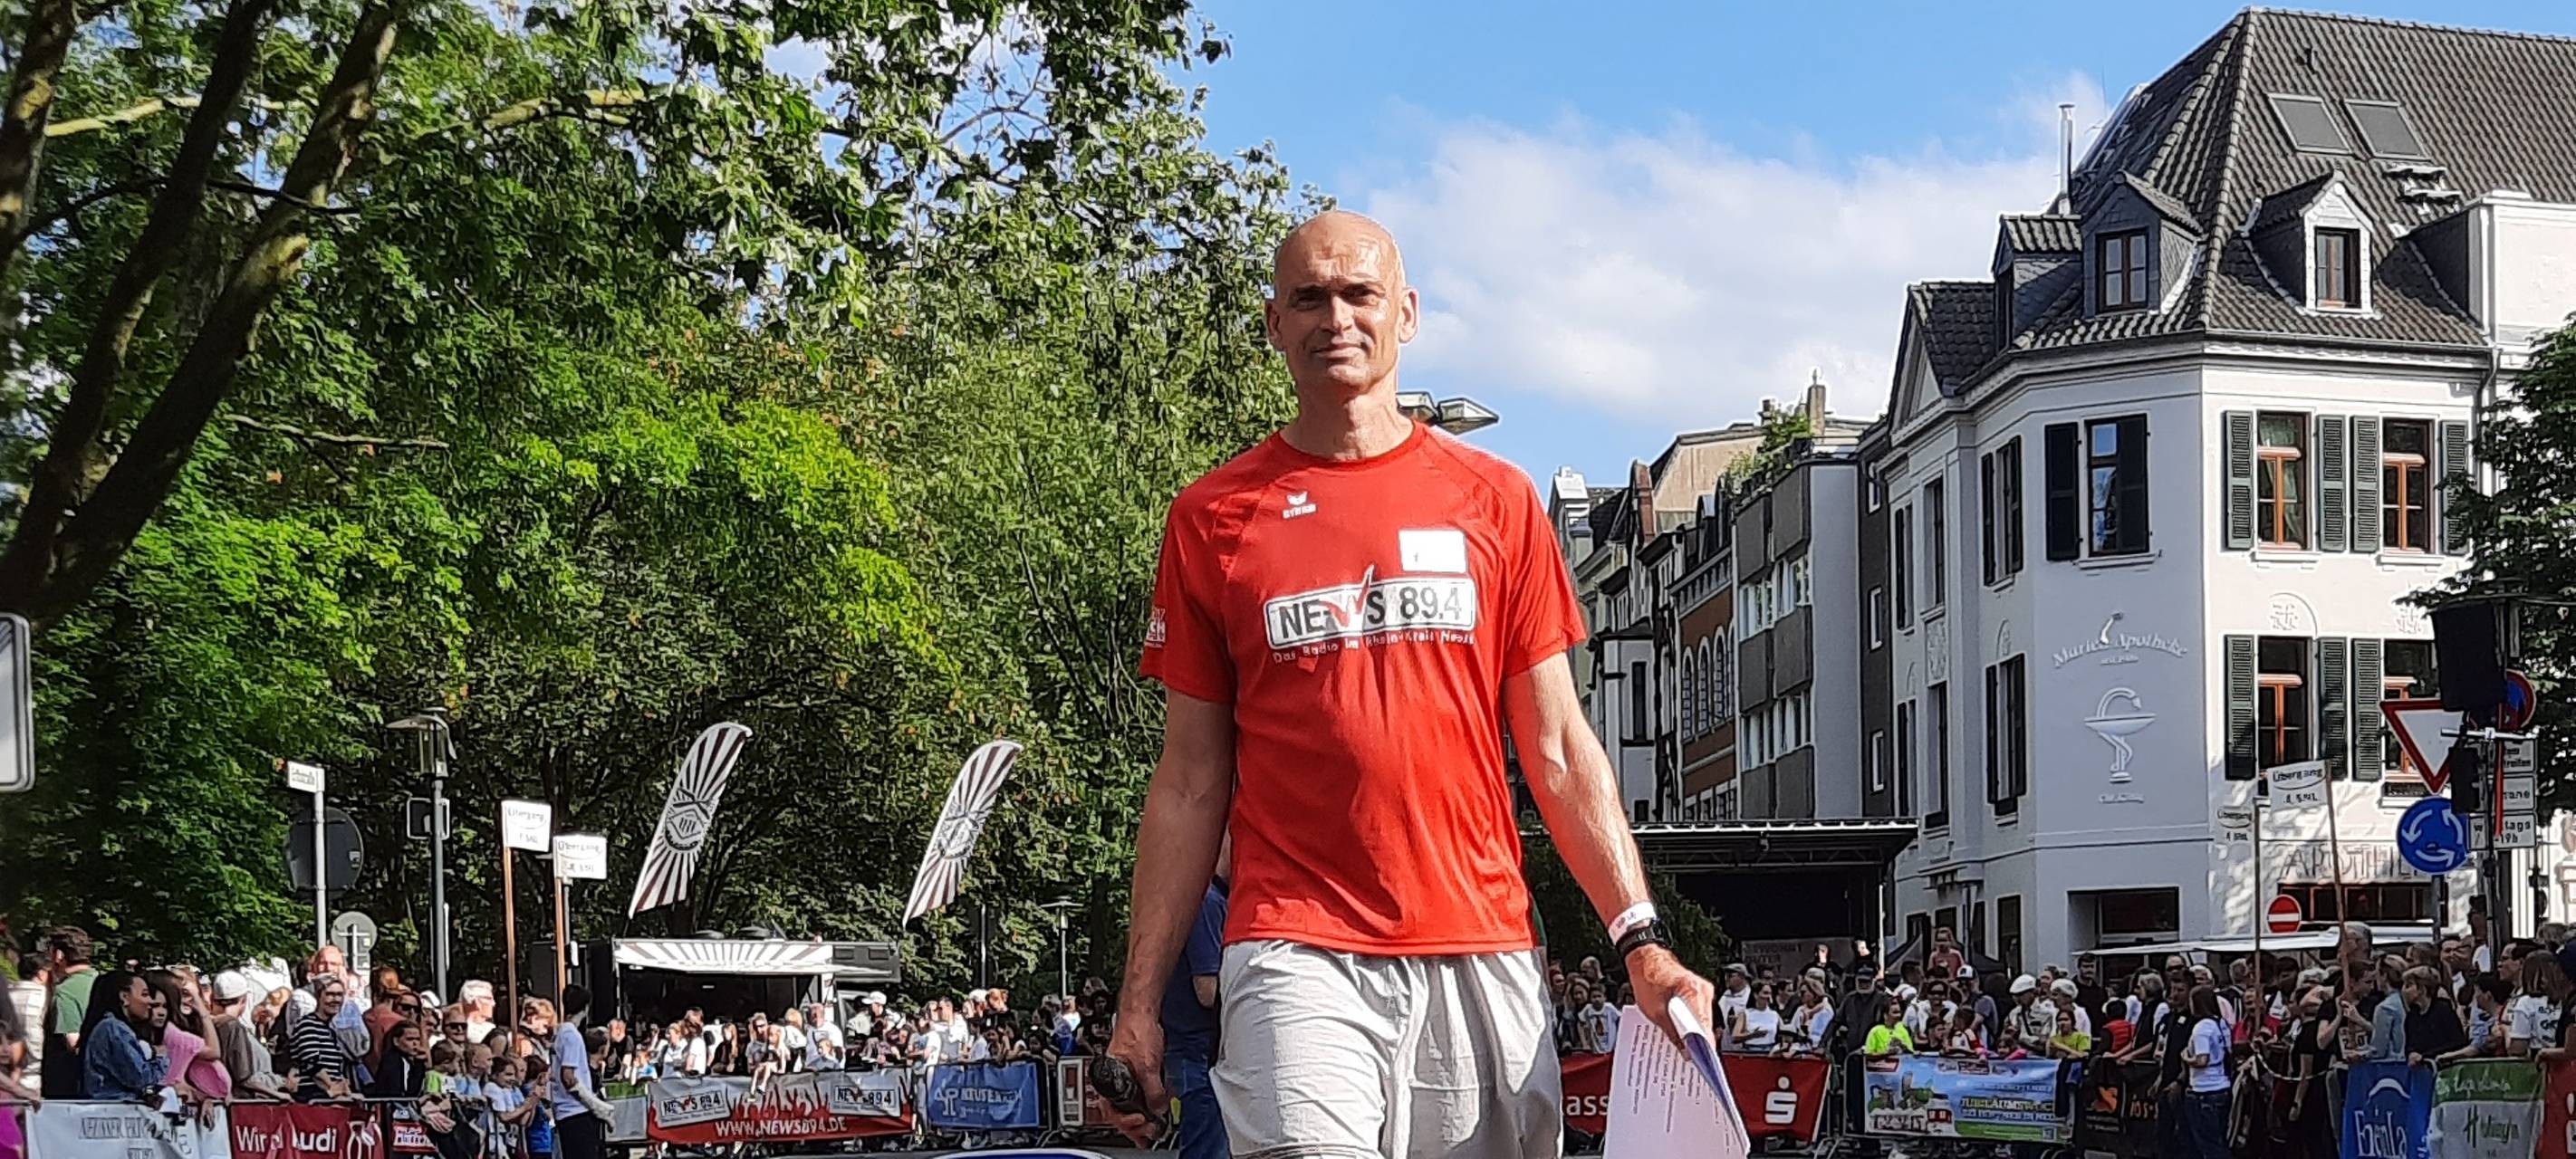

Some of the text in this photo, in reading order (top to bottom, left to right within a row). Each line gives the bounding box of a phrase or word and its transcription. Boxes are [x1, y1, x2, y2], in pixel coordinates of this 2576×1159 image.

[1399, 586, 1463, 624] 89.4
[1302, 642, 1339, 656] Radio
[2116, 633, 2187, 659] Apotheke
[1566, 1096, 1609, 1116] ass
